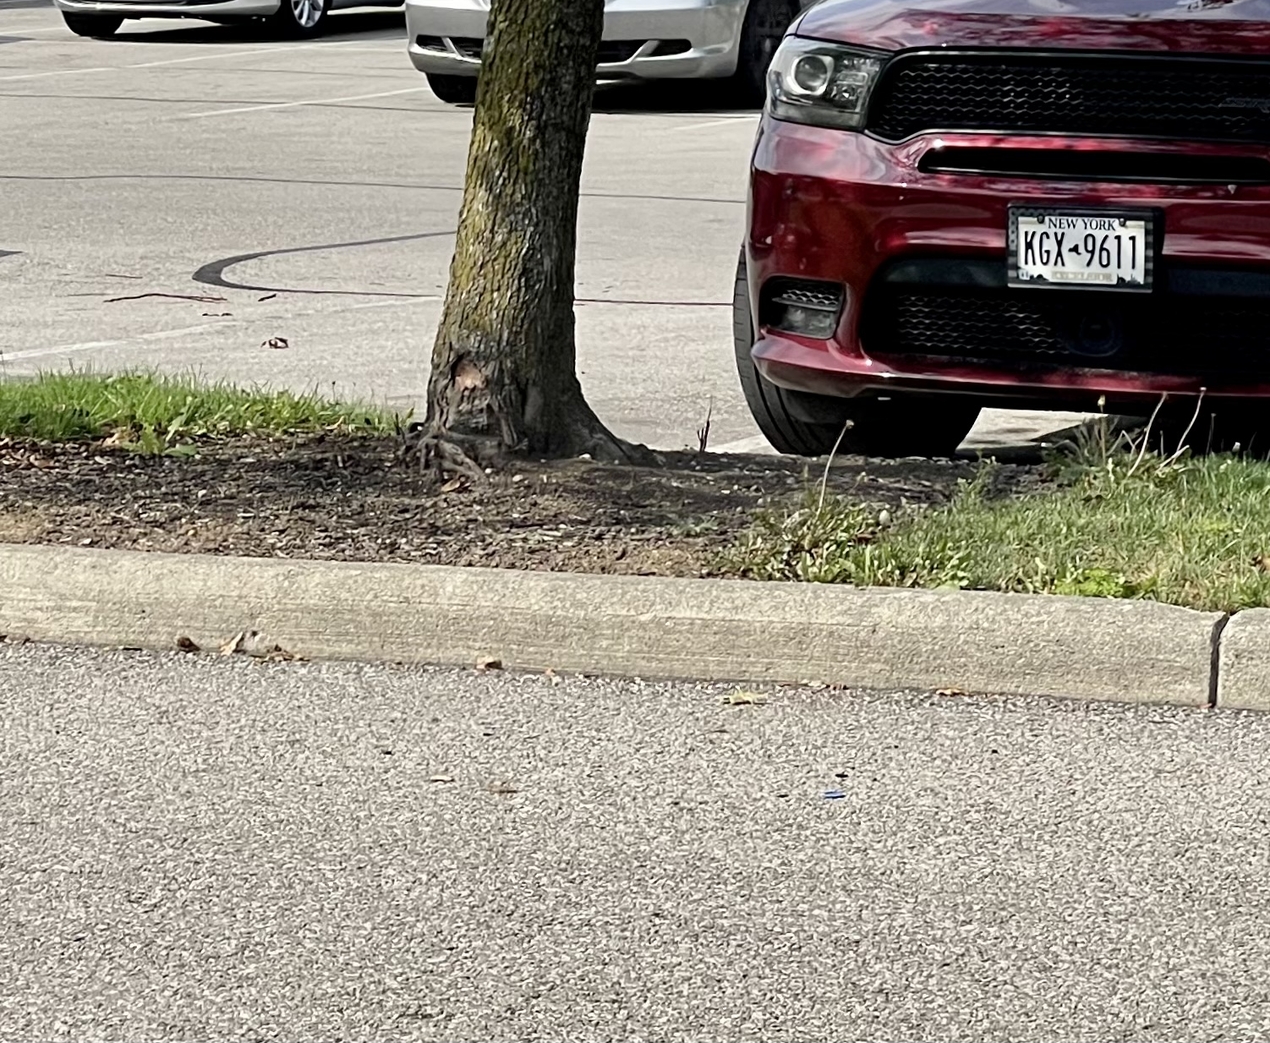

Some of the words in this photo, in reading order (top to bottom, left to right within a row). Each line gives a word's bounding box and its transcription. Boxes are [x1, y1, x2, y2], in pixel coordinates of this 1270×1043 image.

[1047, 218, 1079, 230] NEW
[1081, 218, 1117, 232] YORK
[1083, 233, 1137, 270] 9611
